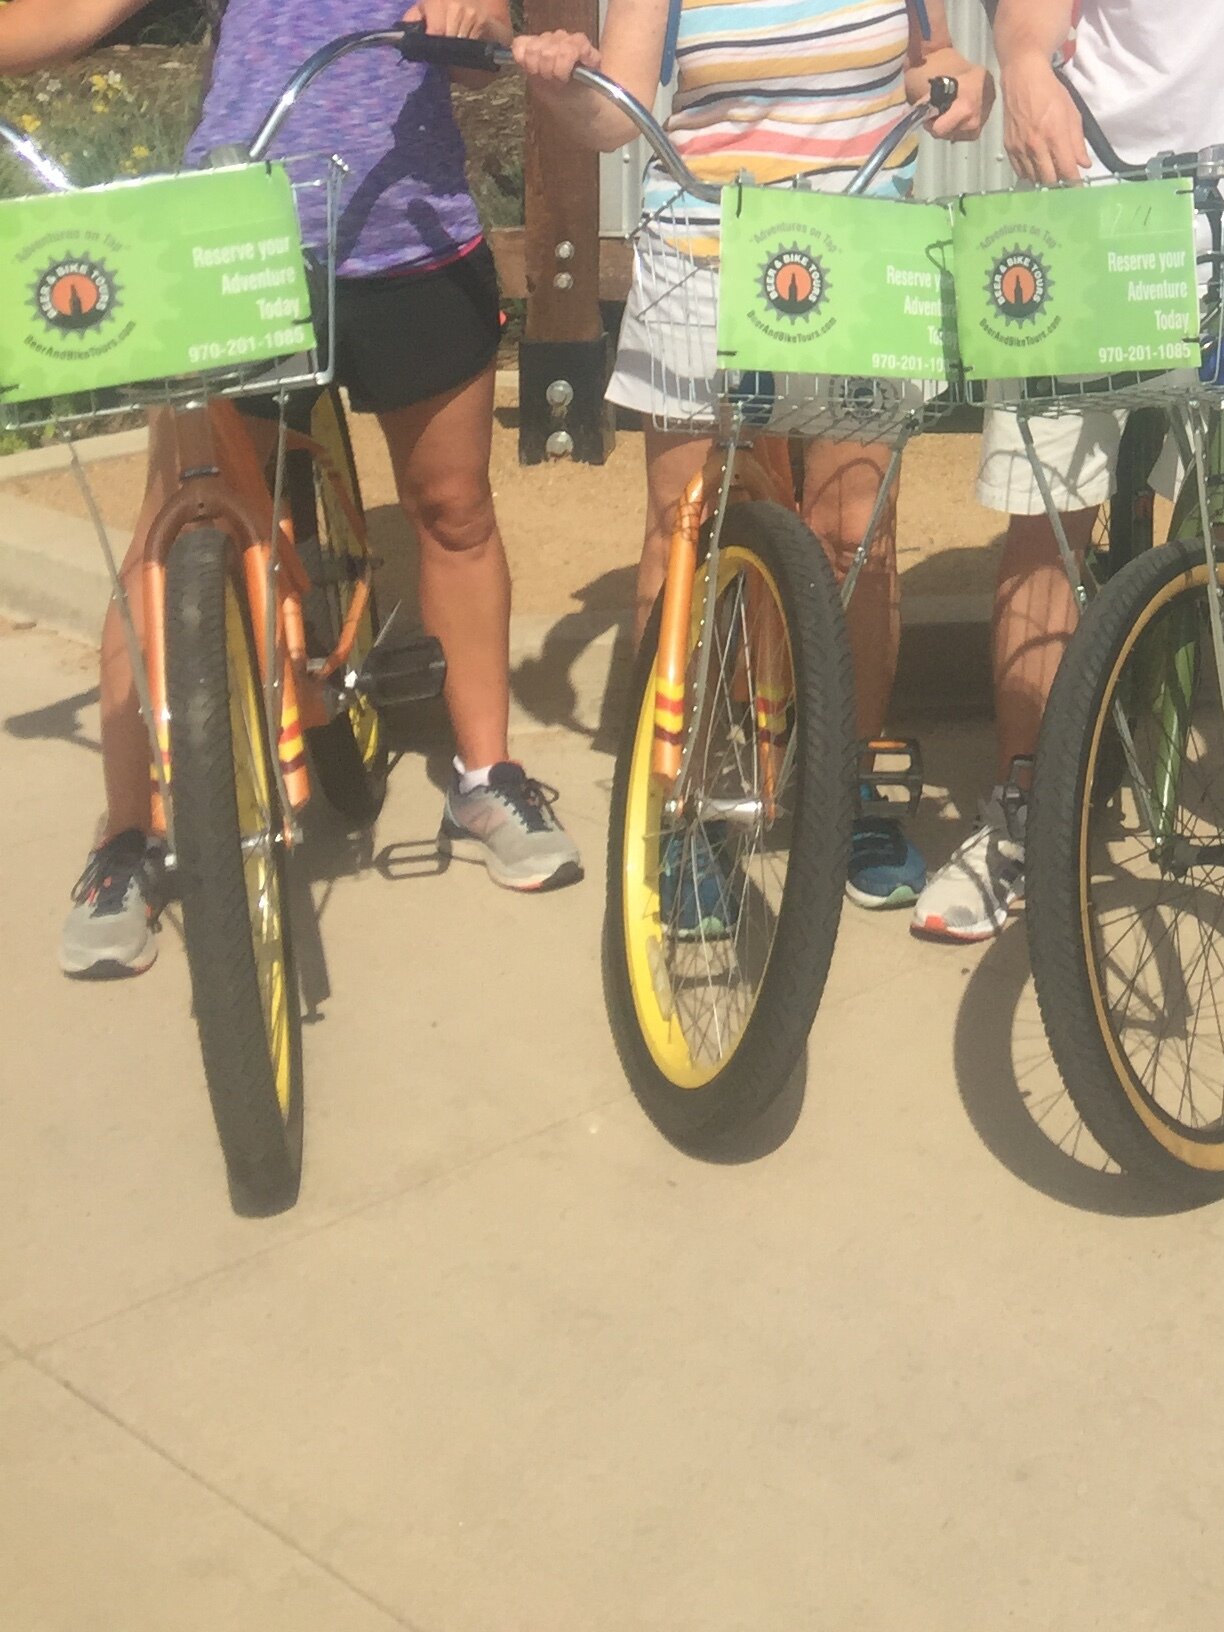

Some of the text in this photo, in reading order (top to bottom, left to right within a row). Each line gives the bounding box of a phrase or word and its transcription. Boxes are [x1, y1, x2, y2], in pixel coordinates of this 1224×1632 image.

[192, 236, 290, 268] Reserve your
[1108, 251, 1186, 273] Reserve your
[55, 263, 89, 277] BIKE
[91, 269, 109, 311] TOURS
[222, 266, 296, 295] Adventure
[766, 268, 778, 300] BEER
[783, 253, 809, 267] BIKE
[809, 263, 822, 303] TOURS
[886, 264, 932, 288] Reserve
[994, 274, 1005, 305] BEER
[1006, 256, 1030, 267] BIKE
[1031, 264, 1043, 303] TOURS
[1128, 280, 1188, 301] Adventure
[256, 296, 300, 320] Today
[1155, 309, 1189, 333] Today
[1099, 343, 1191, 363] 970-201-1085
